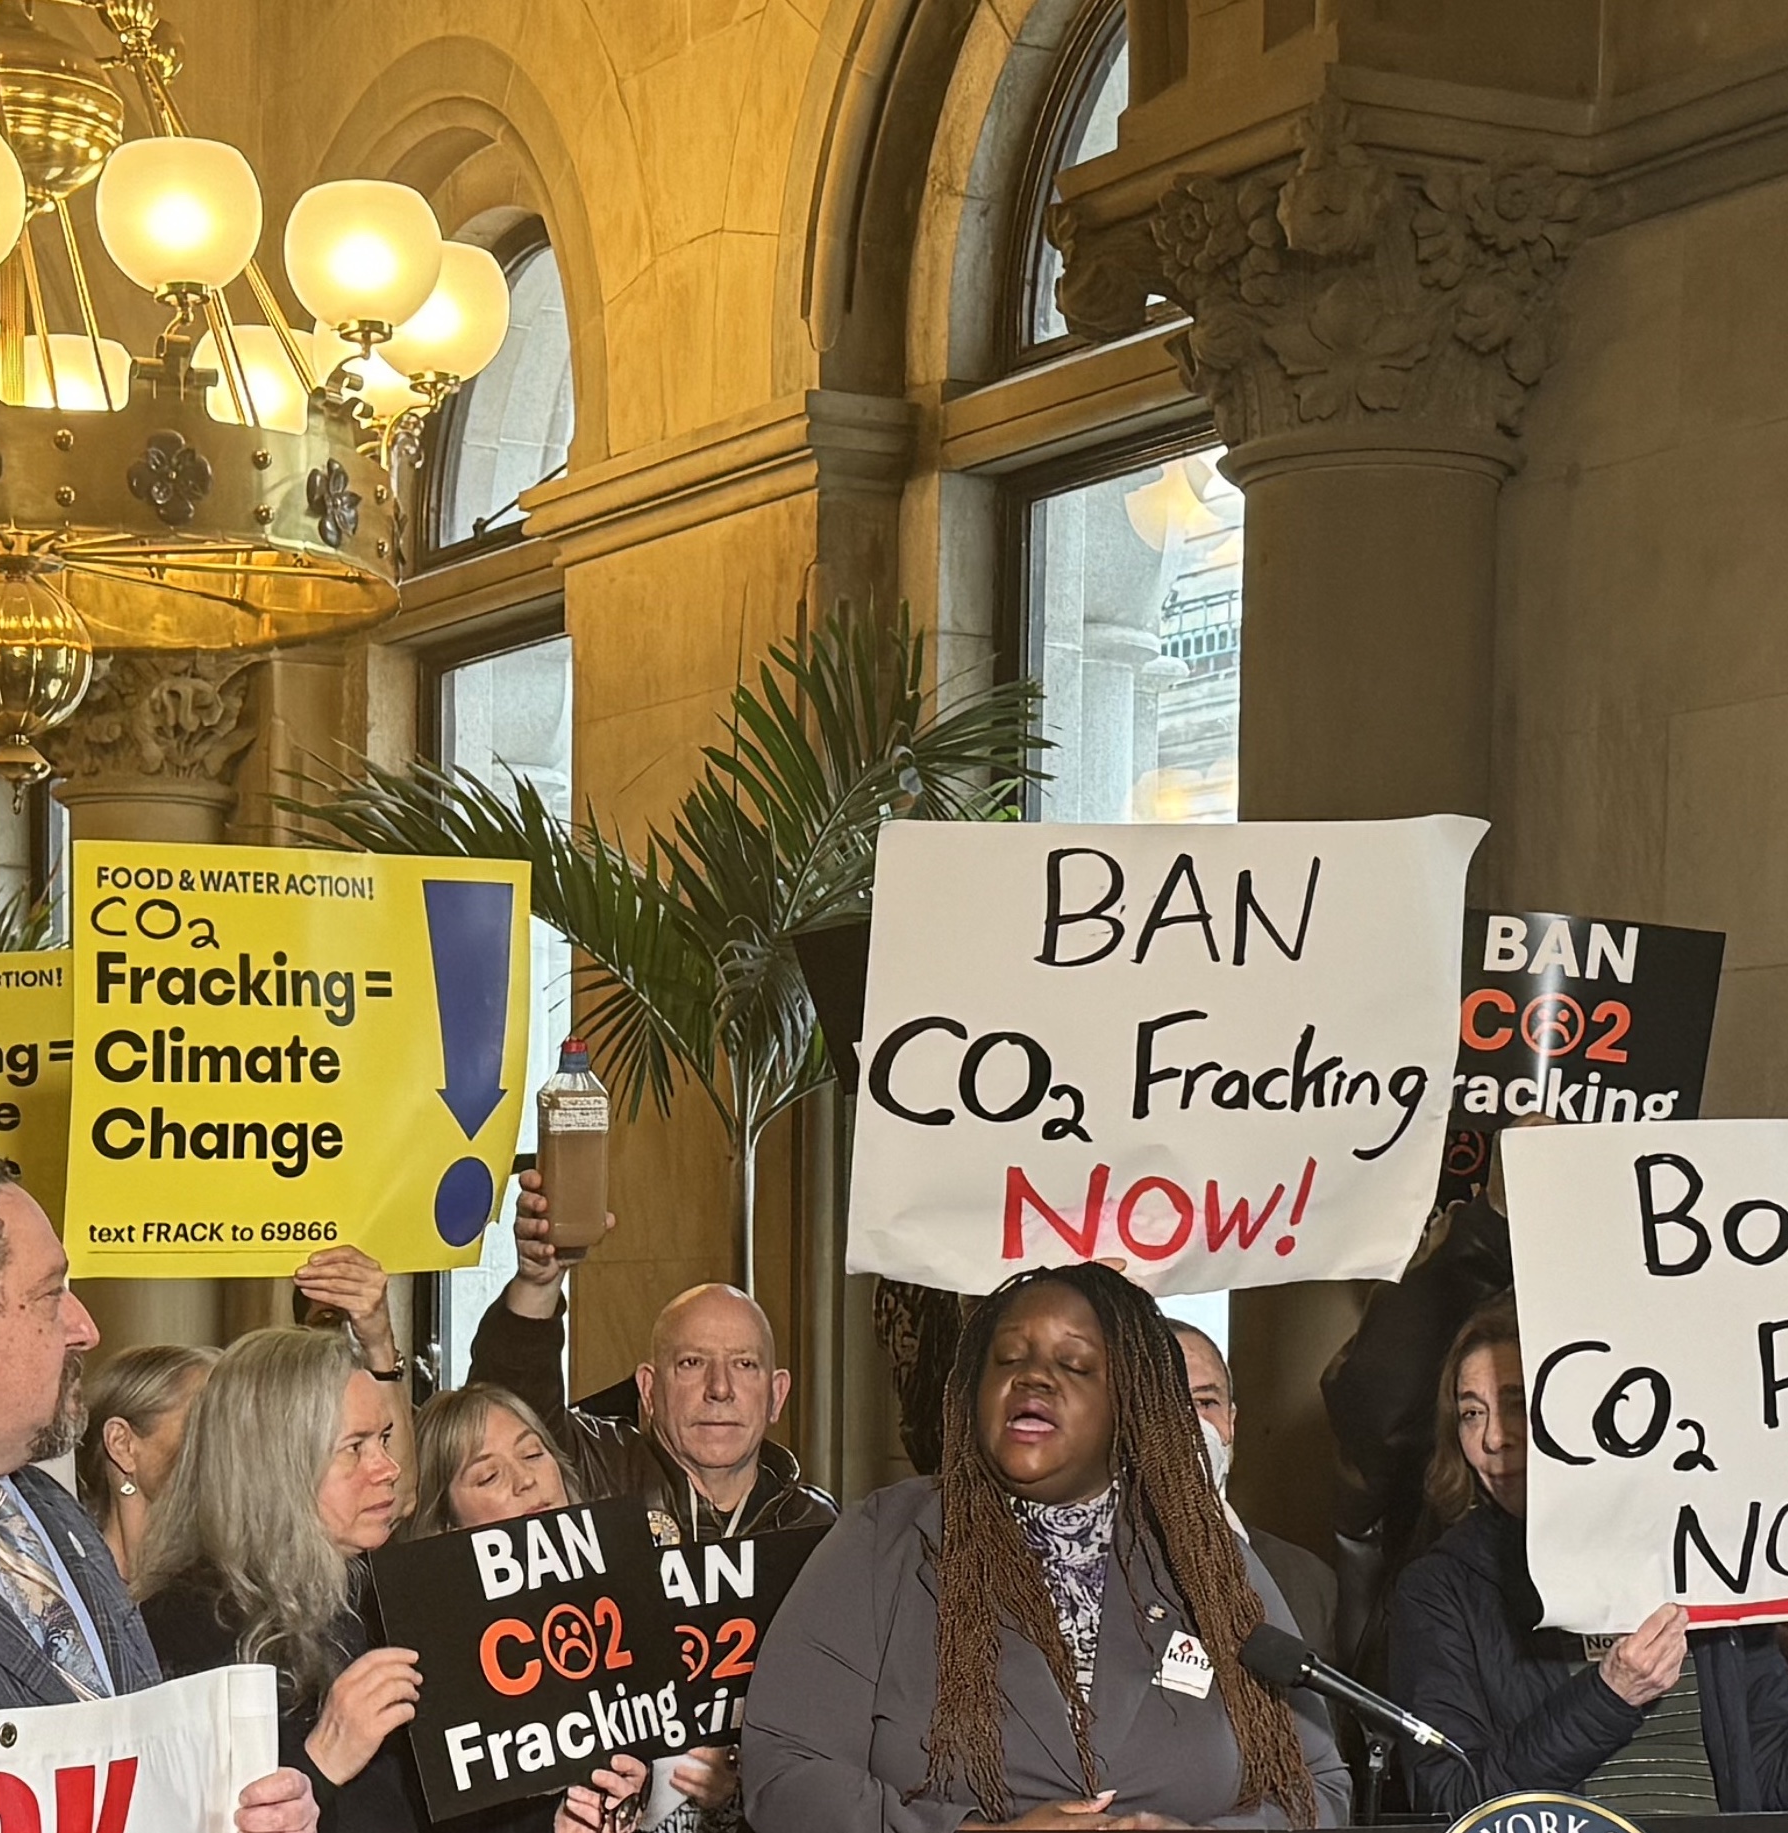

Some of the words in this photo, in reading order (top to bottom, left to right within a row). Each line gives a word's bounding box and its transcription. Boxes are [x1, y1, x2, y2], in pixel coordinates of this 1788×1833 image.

[97, 866, 173, 890] FOOD
[179, 869, 196, 892] &
[200, 870, 279, 894] WATER
[285, 874, 374, 900] ACTION!
[1034, 847, 1321, 968] BAN
[1483, 915, 1639, 983] BAN
[94, 1026, 341, 1083] Climate
[1132, 1009, 1428, 1160] Fracking
[1453, 1068, 1679, 1122] racking
[92, 1107, 343, 1178] Change
[89, 1224, 135, 1243] text
[143, 1222, 225, 1243] FRACK
[231, 1224, 254, 1242] to
[261, 1222, 337, 1242] 69866
[1001, 1155, 1317, 1260] NOW!
[471, 1509, 606, 1601] BAN
[660, 1539, 755, 1607] AN
[444, 1681, 686, 1792] Fracking
